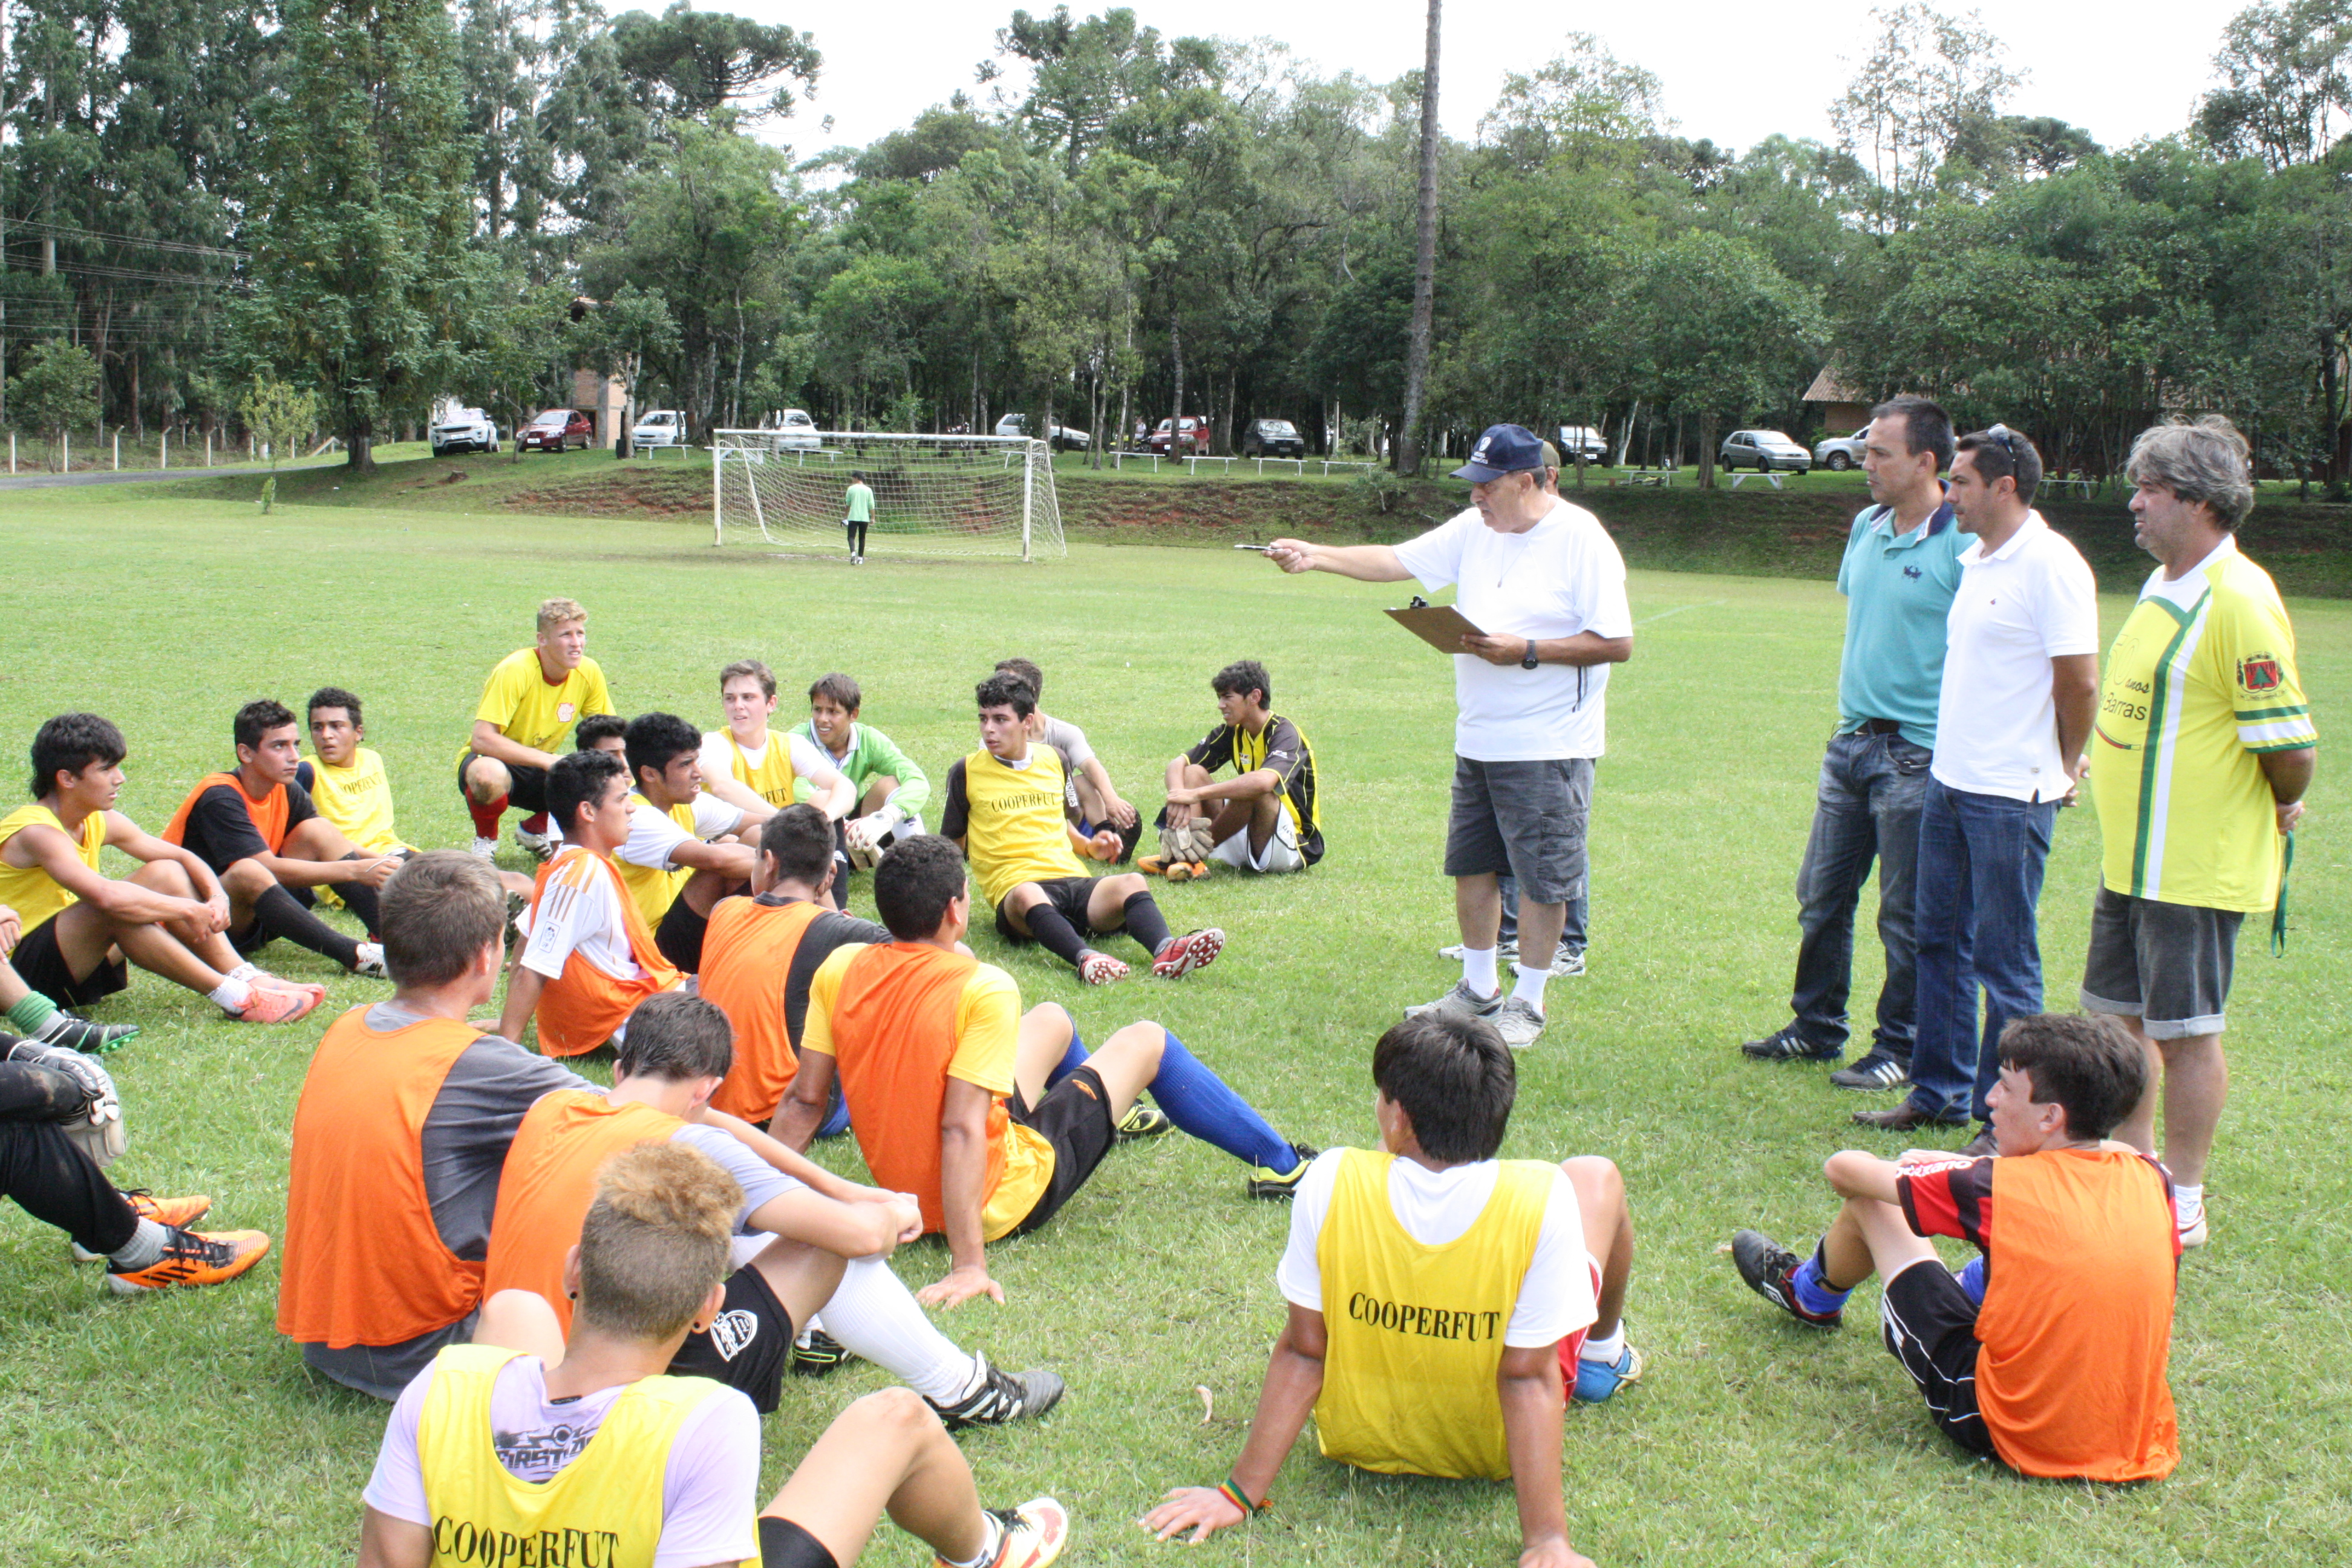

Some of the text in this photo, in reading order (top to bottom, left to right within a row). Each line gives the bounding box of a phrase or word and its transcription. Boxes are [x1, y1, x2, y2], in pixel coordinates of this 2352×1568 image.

[2125, 678, 2150, 694] anos
[2103, 691, 2148, 721] Barras
[991, 792, 1056, 812] COOPERFUT
[1348, 1292, 1500, 1342] COOPERFUT
[434, 1515, 619, 1568] COOPERFUT
